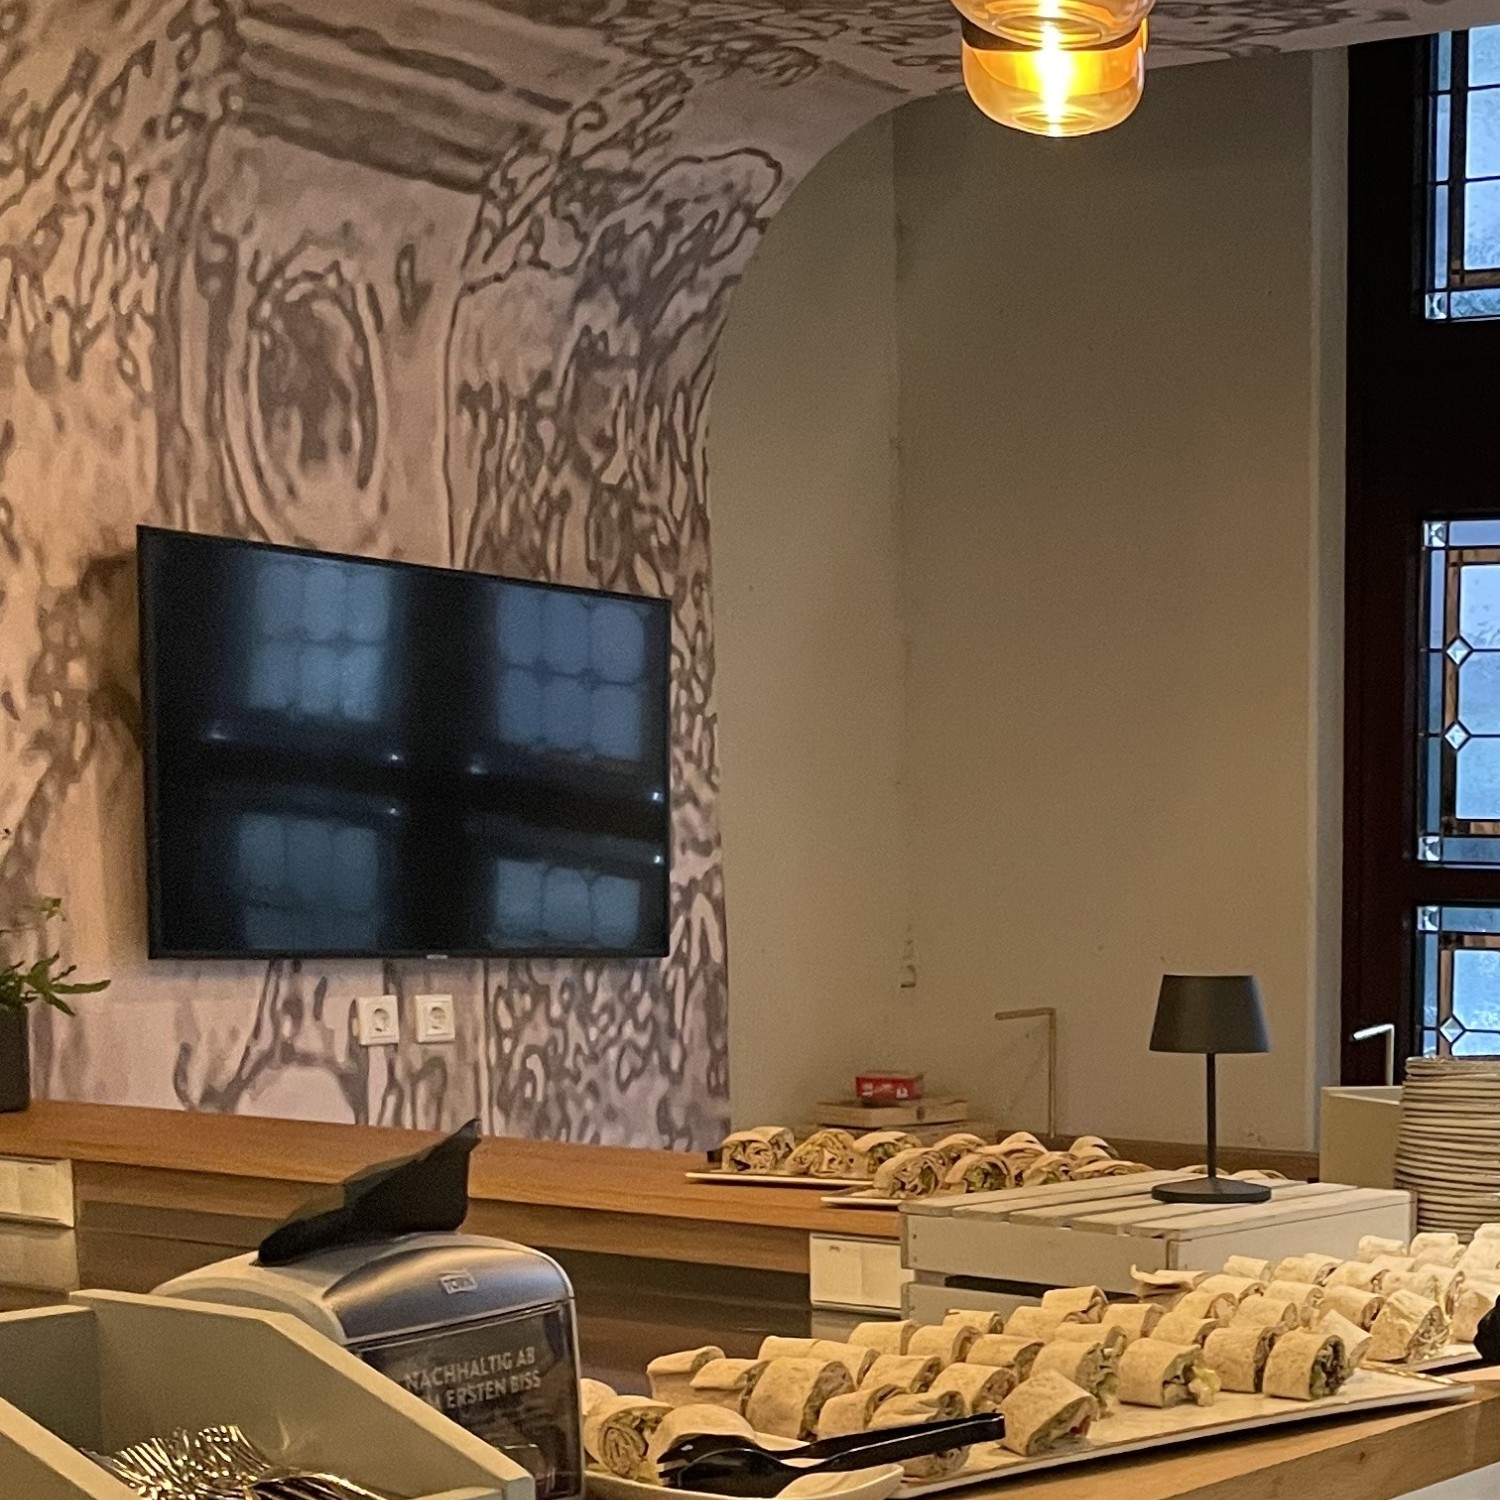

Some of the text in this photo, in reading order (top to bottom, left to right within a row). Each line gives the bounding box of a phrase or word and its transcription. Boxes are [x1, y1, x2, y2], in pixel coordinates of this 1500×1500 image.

[403, 1347, 536, 1390] NACHHALTIG AB
[446, 1378, 506, 1409] ERSTEN
[510, 1370, 542, 1394] BISS
